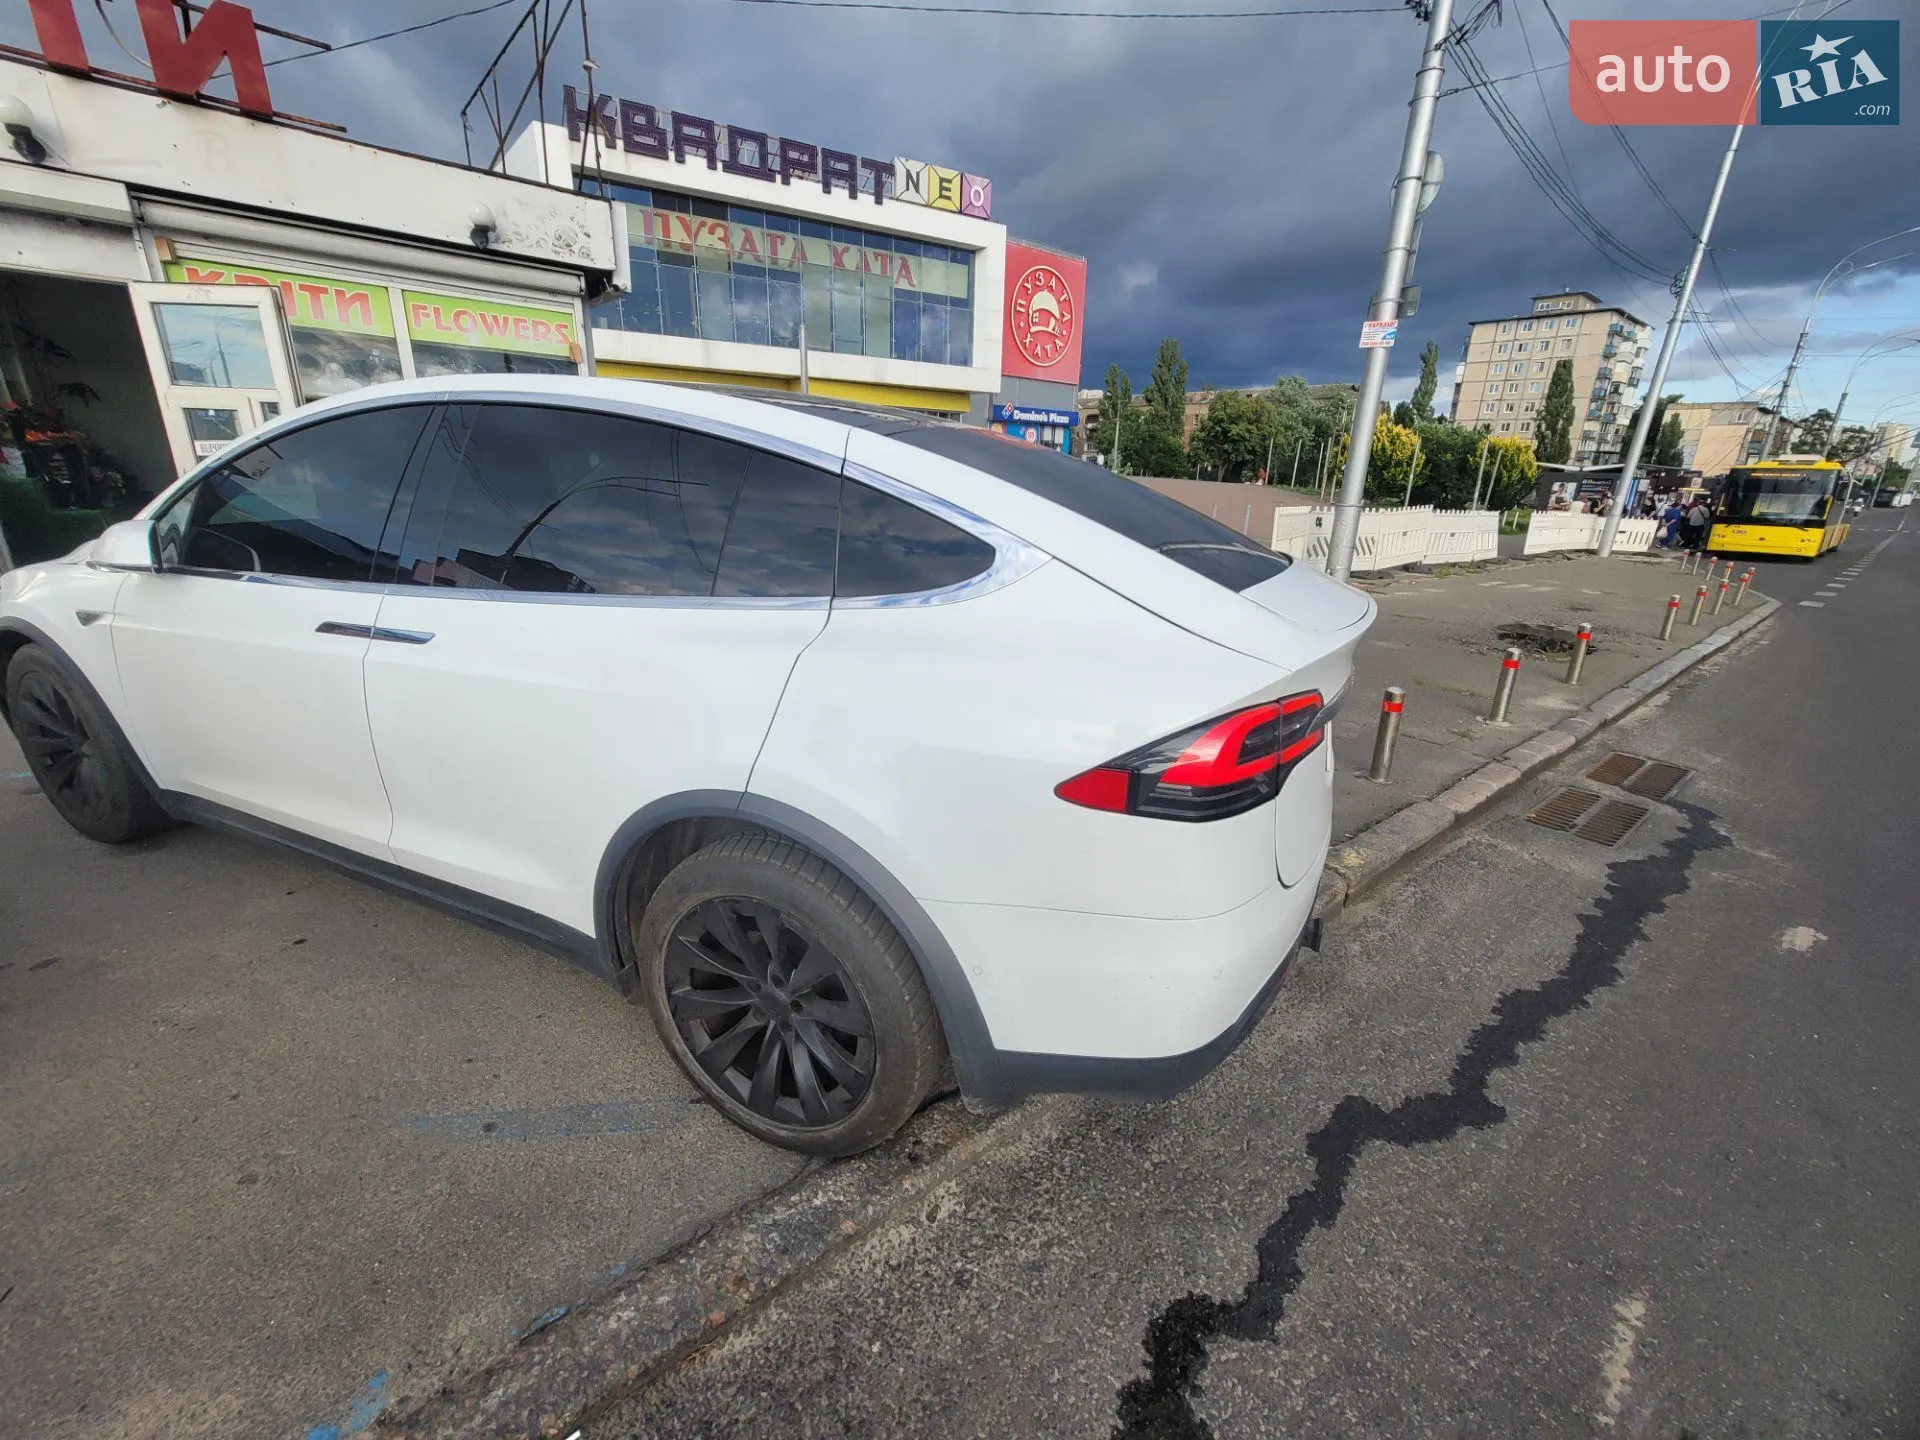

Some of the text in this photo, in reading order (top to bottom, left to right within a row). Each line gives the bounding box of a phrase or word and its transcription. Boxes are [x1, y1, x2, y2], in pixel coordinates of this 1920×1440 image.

[562, 84, 985, 207] КВАДРАТ NEO
[639, 208, 916, 288] ПУЗАТА ХАТА
[1016, 271, 1071, 323] ПУЗАТА
[410, 302, 570, 345] FLOWERS
[1022, 332, 1064, 358] ХАТА
[1013, 410, 1070, 424] Domino's Pizza
